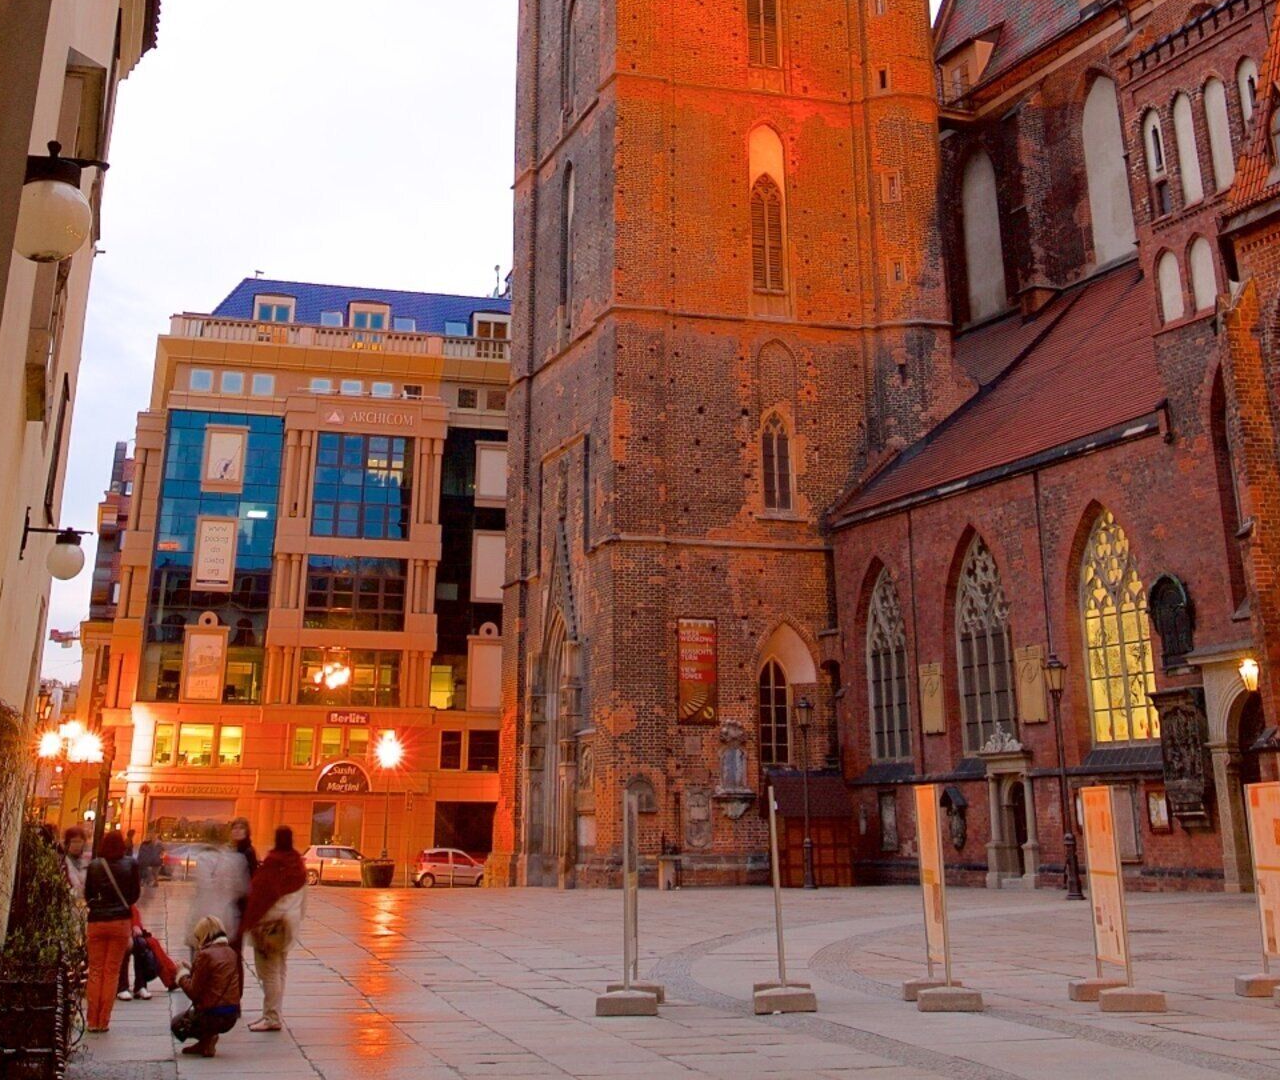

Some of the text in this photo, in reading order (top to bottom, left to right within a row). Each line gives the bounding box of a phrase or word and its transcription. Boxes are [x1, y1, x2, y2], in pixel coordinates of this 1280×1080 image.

[350, 411, 413, 426] ARCHICOM
[330, 712, 367, 724] Berlitz
[327, 766, 356, 776] Sushi
[339, 775, 348, 783] &
[153, 784, 185, 794] SALON
[326, 782, 360, 792] Martini
